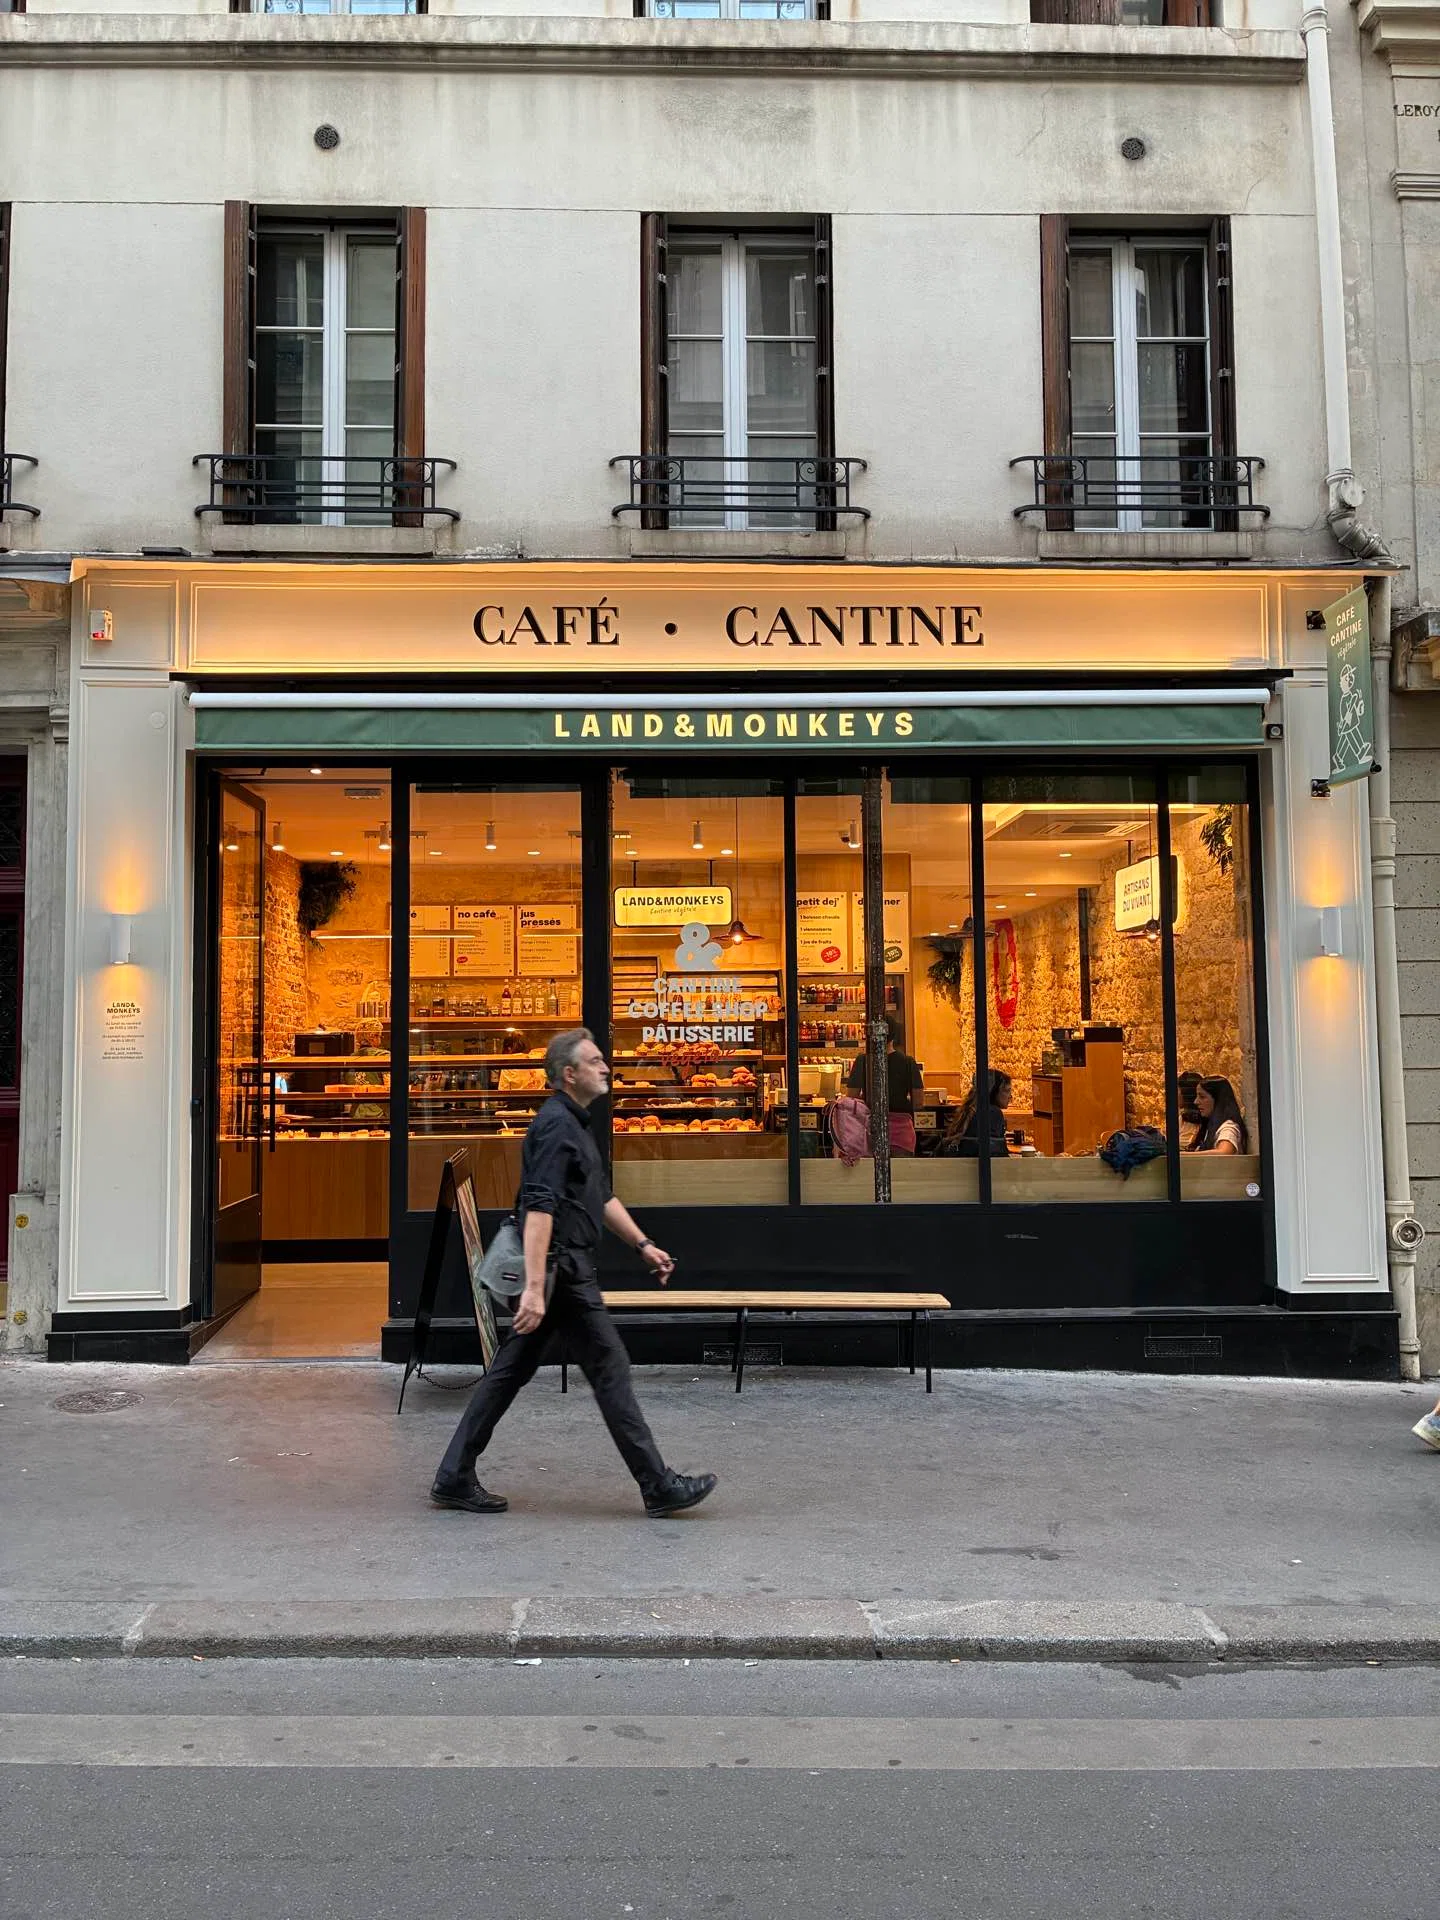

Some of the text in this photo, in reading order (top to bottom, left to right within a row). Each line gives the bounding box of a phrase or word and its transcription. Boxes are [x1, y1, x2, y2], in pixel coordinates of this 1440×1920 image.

[1393, 105, 1440, 117] LEROY
[473, 597, 984, 647] CAFÉ CANTINE
[1330, 619, 1362, 647] CANTINE
[554, 711, 915, 738] LAND&MONKEYS
[1124, 877, 1150, 897] ARTISANS
[622, 895, 724, 906] LAND&MONKEYS
[797, 897, 819, 907] petit
[1123, 900, 1130, 912] DU
[473, 909, 496, 918] café
[520, 909, 535, 919] jus
[521, 918, 561, 928] pressés
[653, 976, 742, 994] CANTINE
[628, 1000, 769, 1019] COFFEE SHOP
[642, 1022, 755, 1042] PÂTISSERIE
